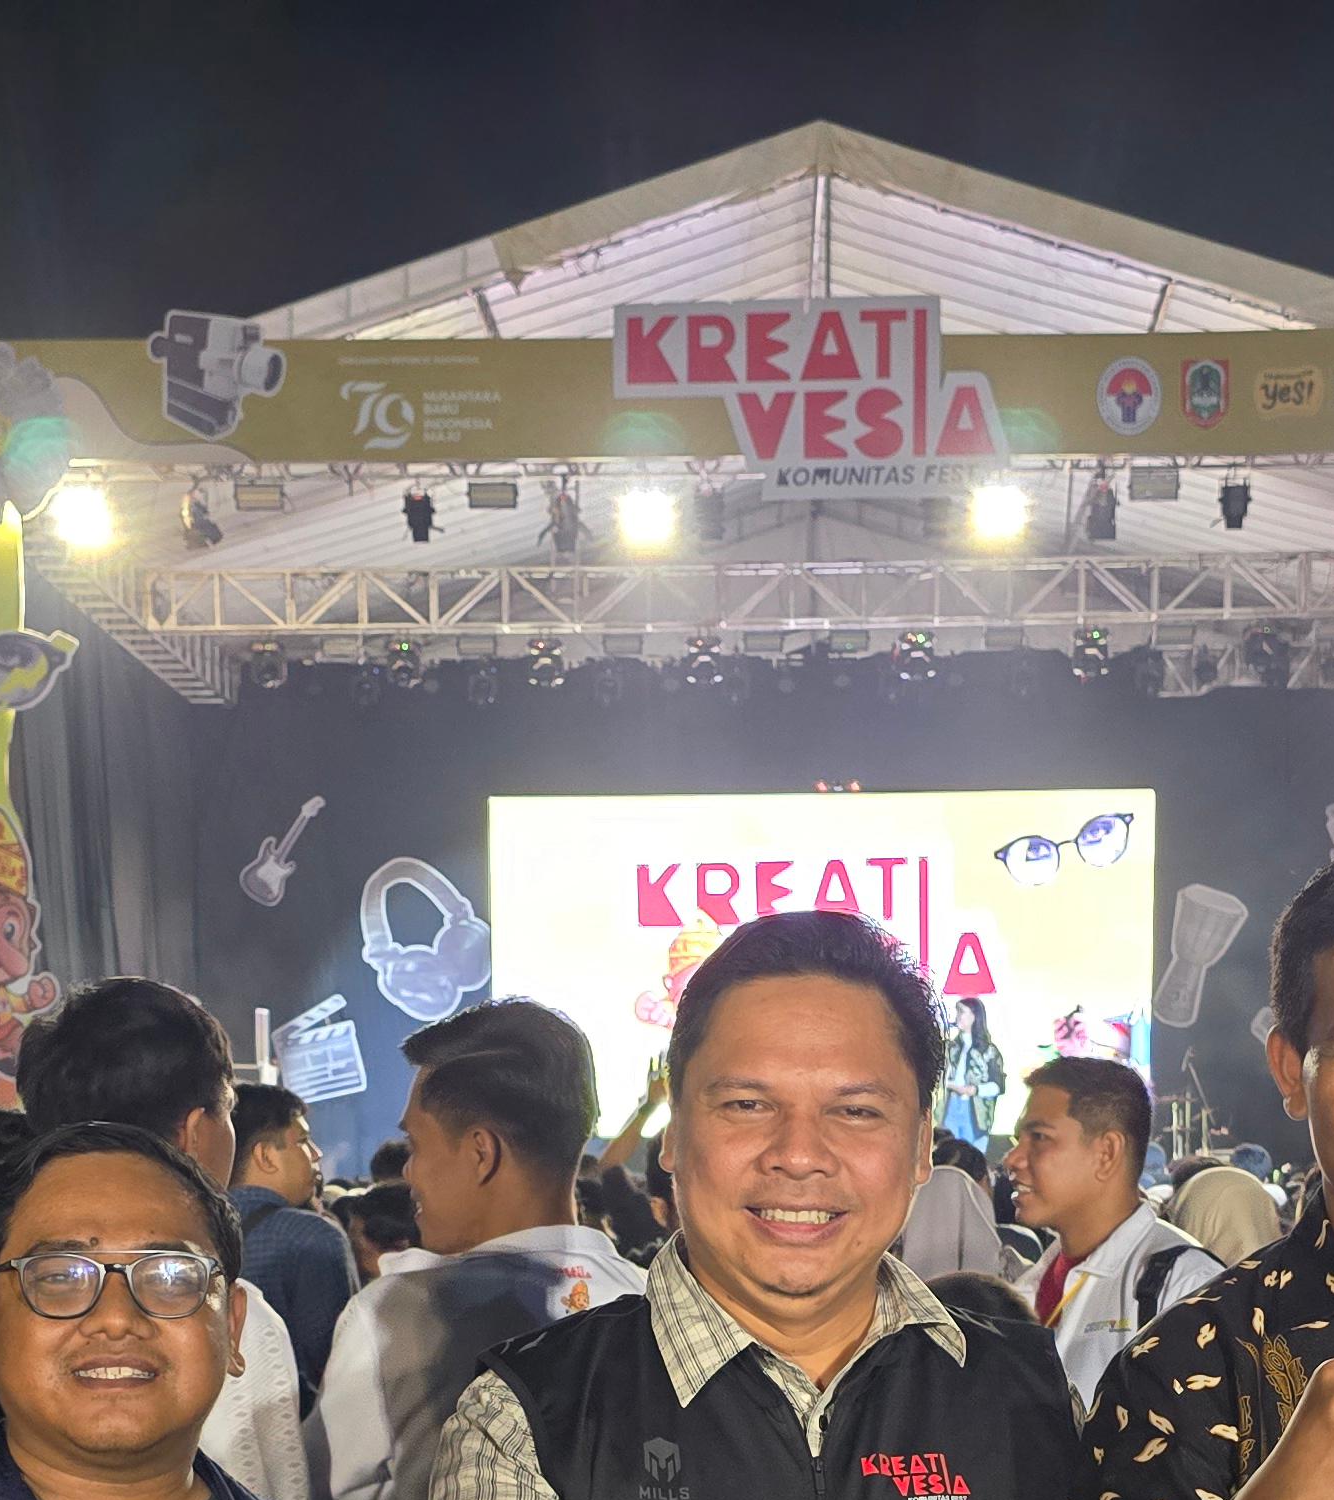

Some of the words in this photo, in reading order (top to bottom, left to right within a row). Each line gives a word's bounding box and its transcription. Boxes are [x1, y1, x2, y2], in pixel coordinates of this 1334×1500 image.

[627, 310, 928, 385] KREATI
[776, 465, 915, 487] KOMUNITAS
[860, 1453, 948, 1477] KREATI
